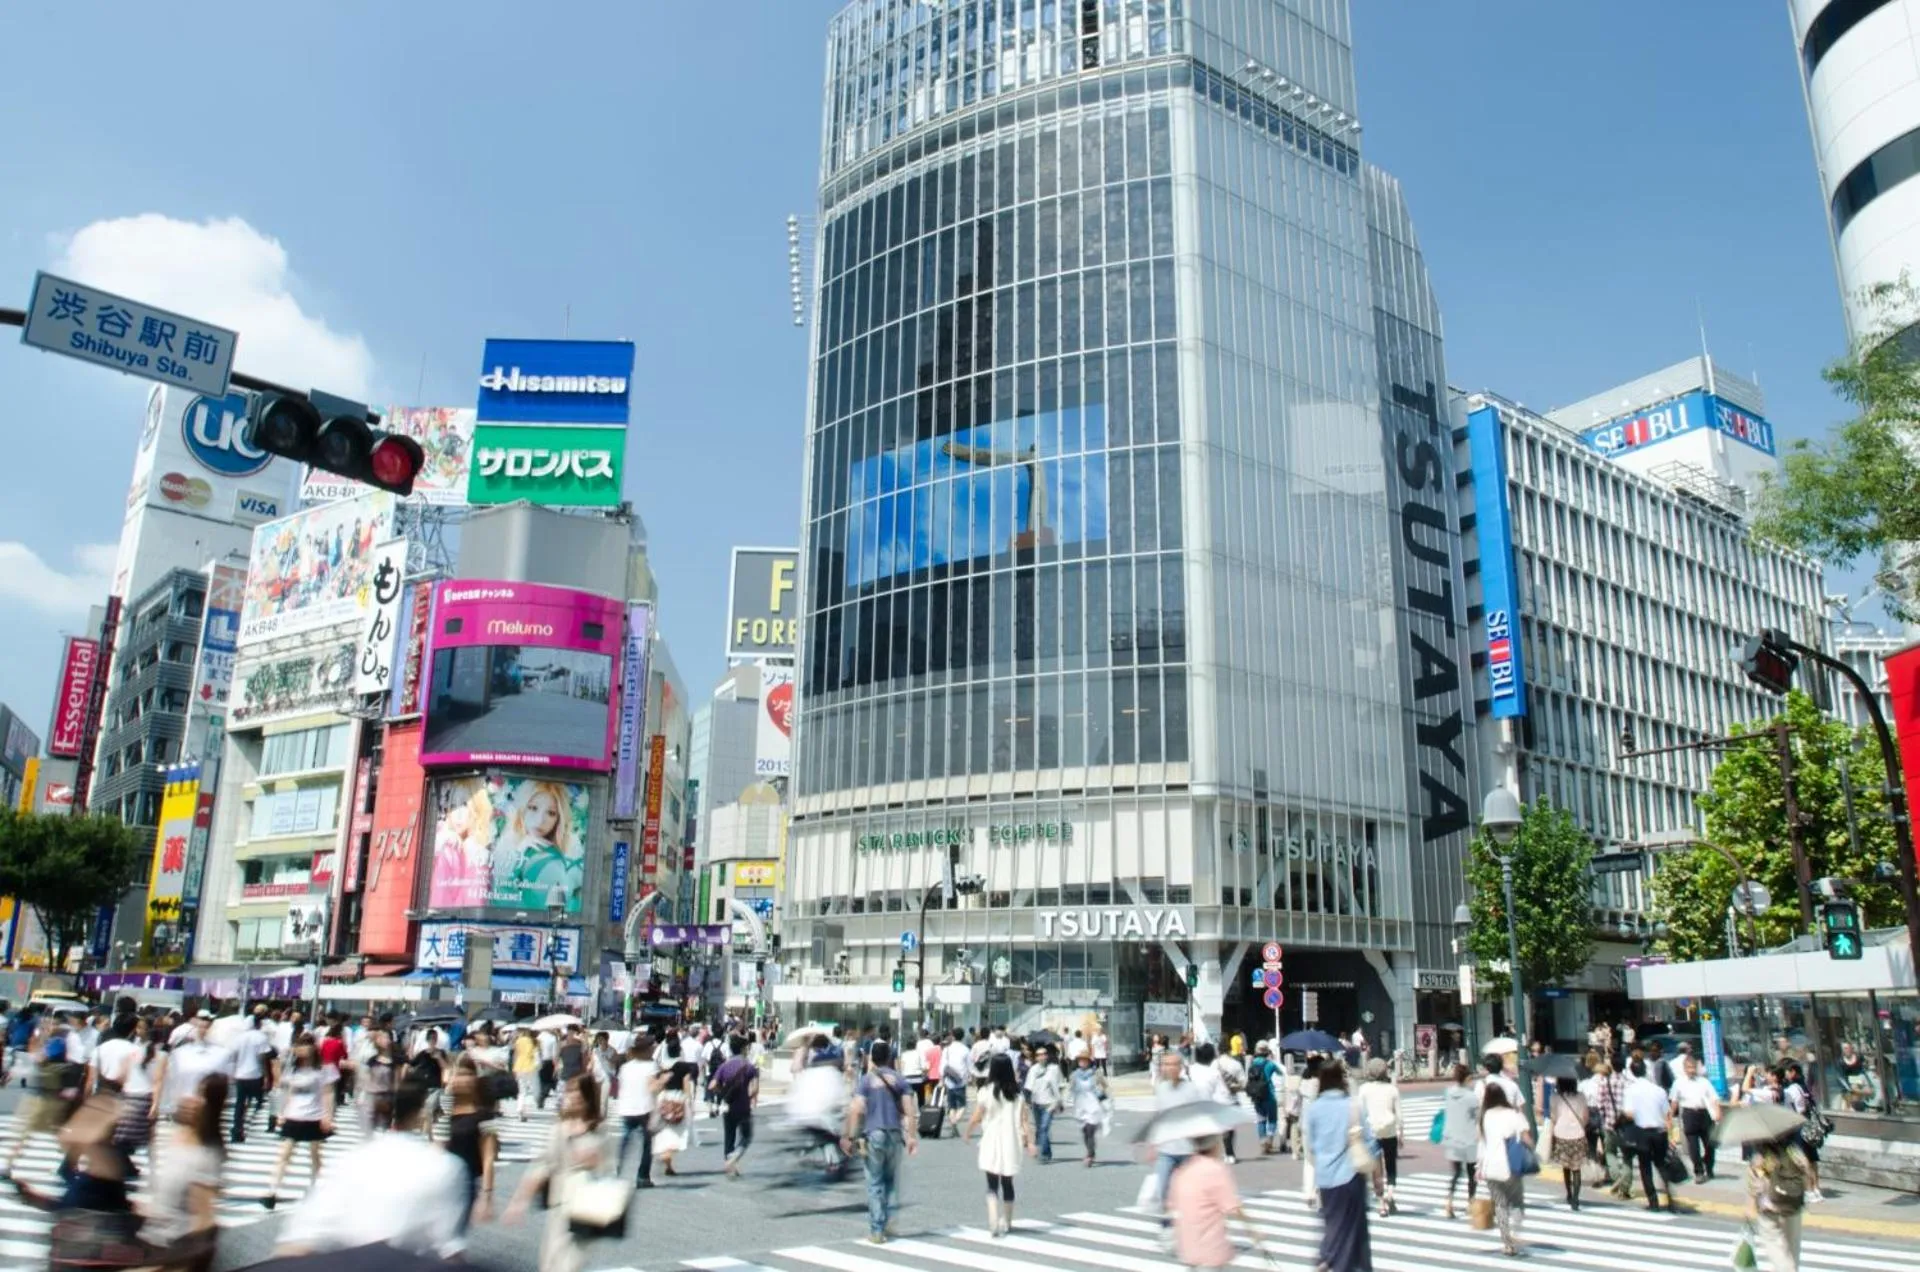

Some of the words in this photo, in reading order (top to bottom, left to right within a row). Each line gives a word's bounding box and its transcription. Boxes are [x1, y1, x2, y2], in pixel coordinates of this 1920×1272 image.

[47, 287, 221, 366] 渋谷駅前
[71, 331, 149, 370] Shibuya
[156, 355, 193, 381] Sta.
[479, 366, 627, 393] Hisamitsu
[1594, 402, 1689, 450] SEIBU
[1716, 405, 1770, 451] SEIBU
[477, 447, 614, 479] サロンパス
[240, 498, 278, 517] VISA
[244, 618, 280, 637] AKB48
[361, 556, 401, 685] もんじゃ
[1392, 380, 1473, 842] TSUTAYA
[487, 619, 553, 637] Melumo
[1487, 610, 1514, 699] SEIBU
[54, 641, 95, 751] Essential
[859, 827, 976, 851] STARBUCKS
[989, 822, 1074, 844] COFFEE
[1271, 834, 1377, 869] TSUTAYA
[1040, 909, 1187, 937] TSUTAYA
[424, 930, 571, 962] 大盛書店
[1420, 973, 1459, 987] TSUTAYA
